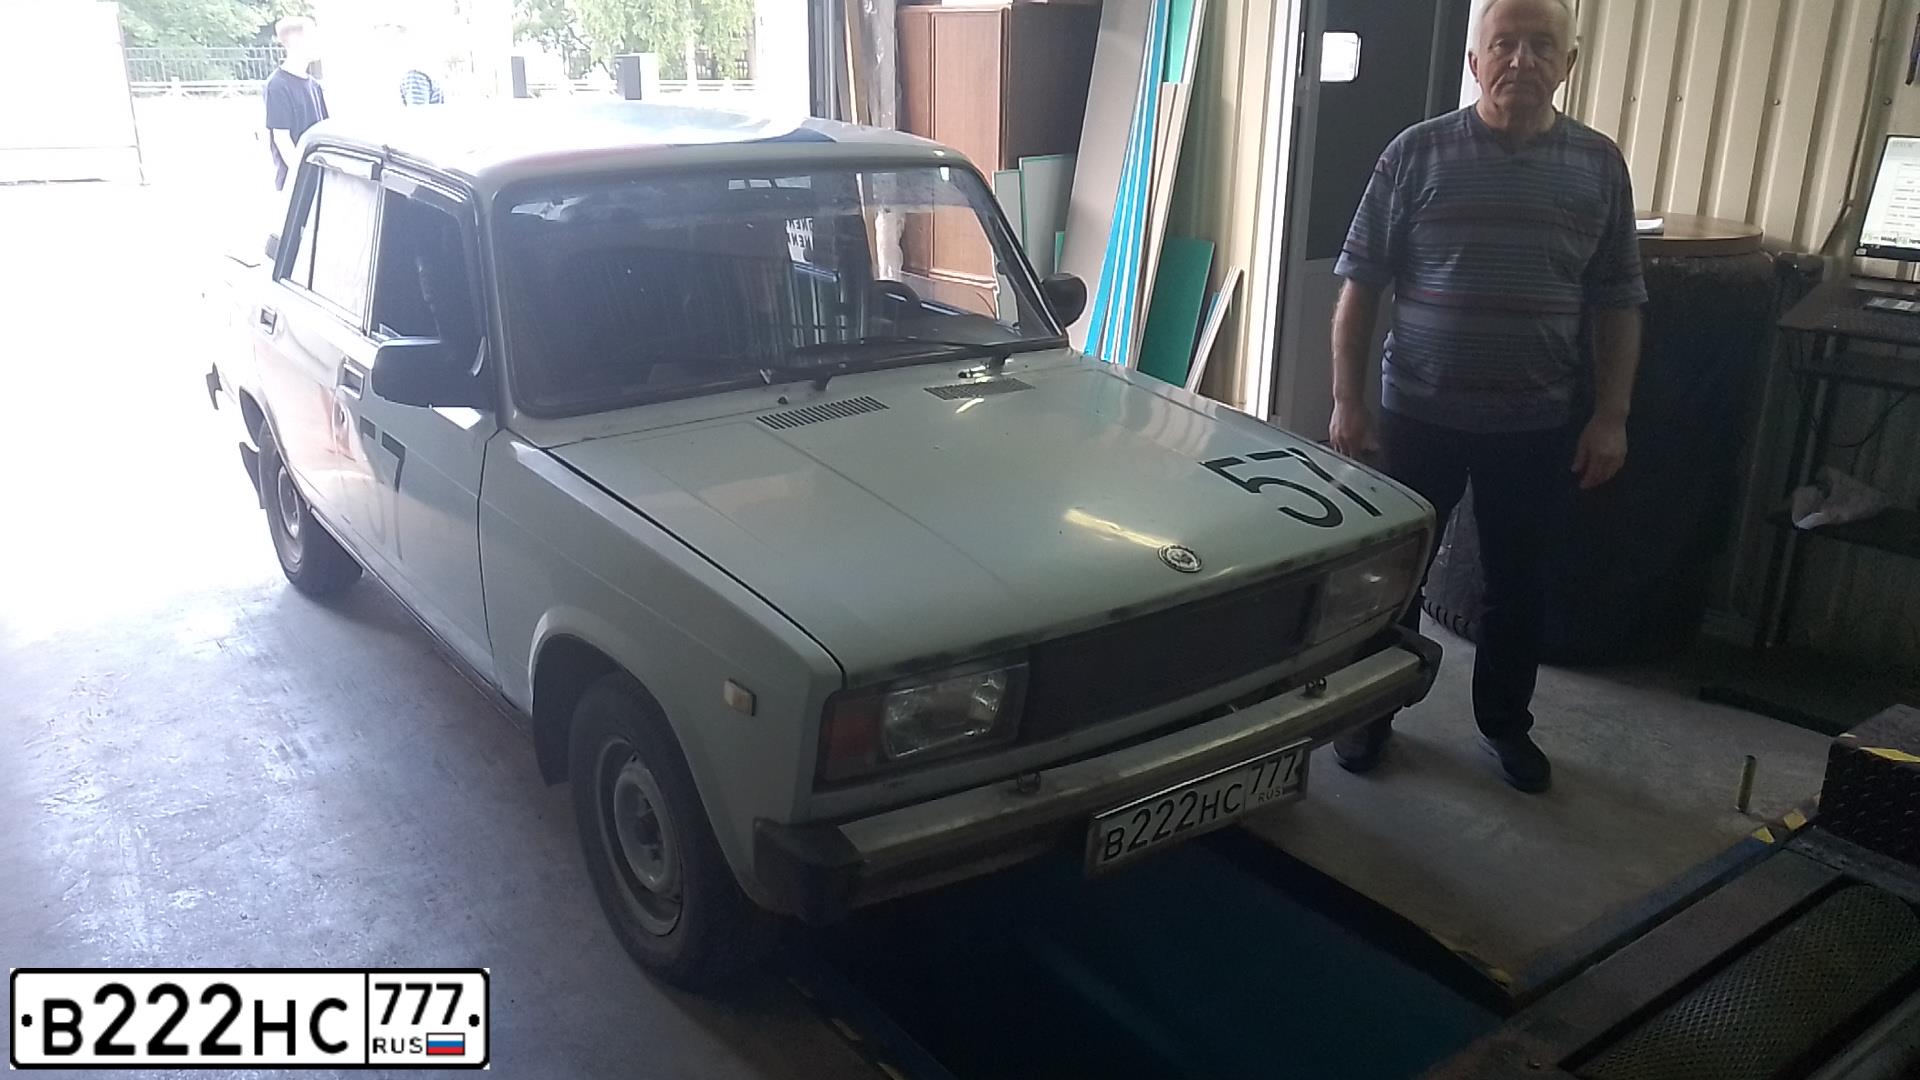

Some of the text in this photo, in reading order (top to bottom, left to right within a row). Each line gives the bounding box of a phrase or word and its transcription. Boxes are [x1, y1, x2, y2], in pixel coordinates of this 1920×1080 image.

[1200, 447, 1383, 528] 57
[1103, 753, 1297, 861] В222НС 777
[1258, 786, 1281, 802] RUS
